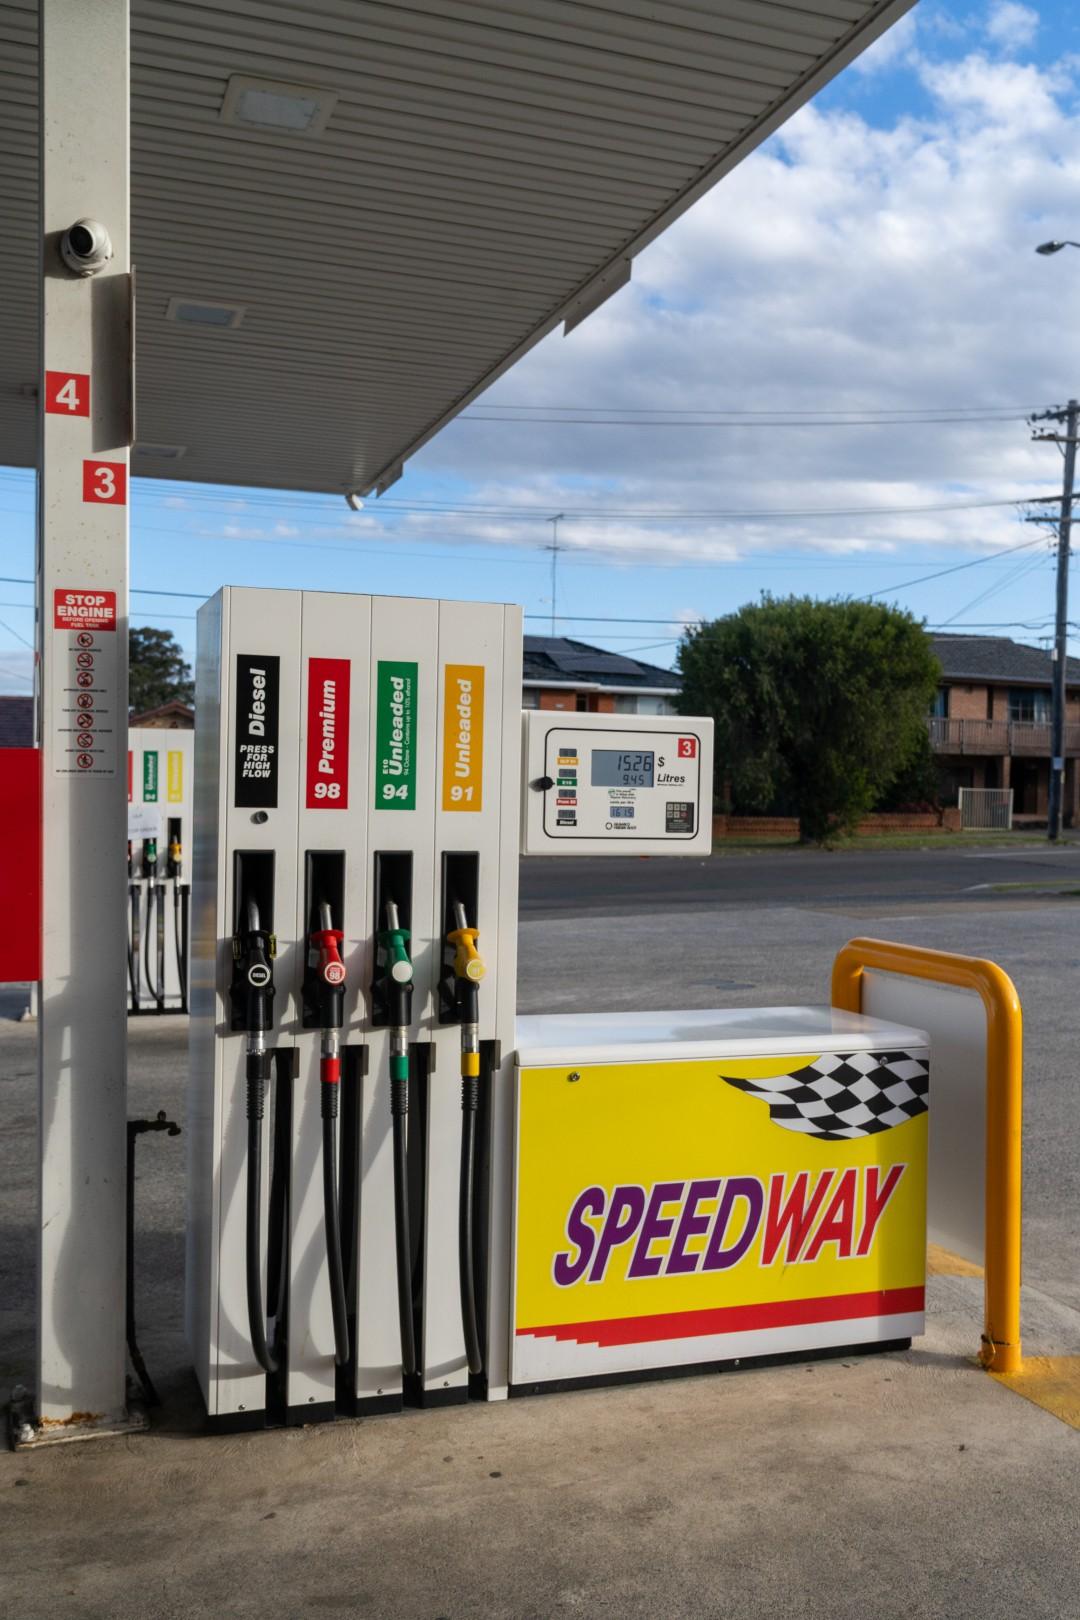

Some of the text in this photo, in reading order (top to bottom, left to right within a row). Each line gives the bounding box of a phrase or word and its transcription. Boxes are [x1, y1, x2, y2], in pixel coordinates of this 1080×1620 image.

[55, 378, 80, 411] 4
[93, 466, 117, 500] 3
[65, 594, 106, 606] STOP
[57, 605, 114, 618] ENGINE
[248, 667, 267, 737] Diesel
[318, 679, 336, 775] Premium
[388, 676, 404, 776] Unleaded
[455, 678, 473, 779] Unleaded
[239, 745, 275, 754] PRESS
[682, 740, 692, 756] 3
[243, 761, 271, 770] HIGH
[246, 753, 268, 762] FOR
[657, 756, 665, 767] $
[242, 769, 272, 778] FLOW
[657, 773, 686, 783] Litres
[314, 782, 341, 799] 98
[382, 783, 409, 800] 94
[451, 785, 474, 801] 91
[329, 971, 341, 980] 98
[551, 1163, 908, 1288] SPEEDWAY
